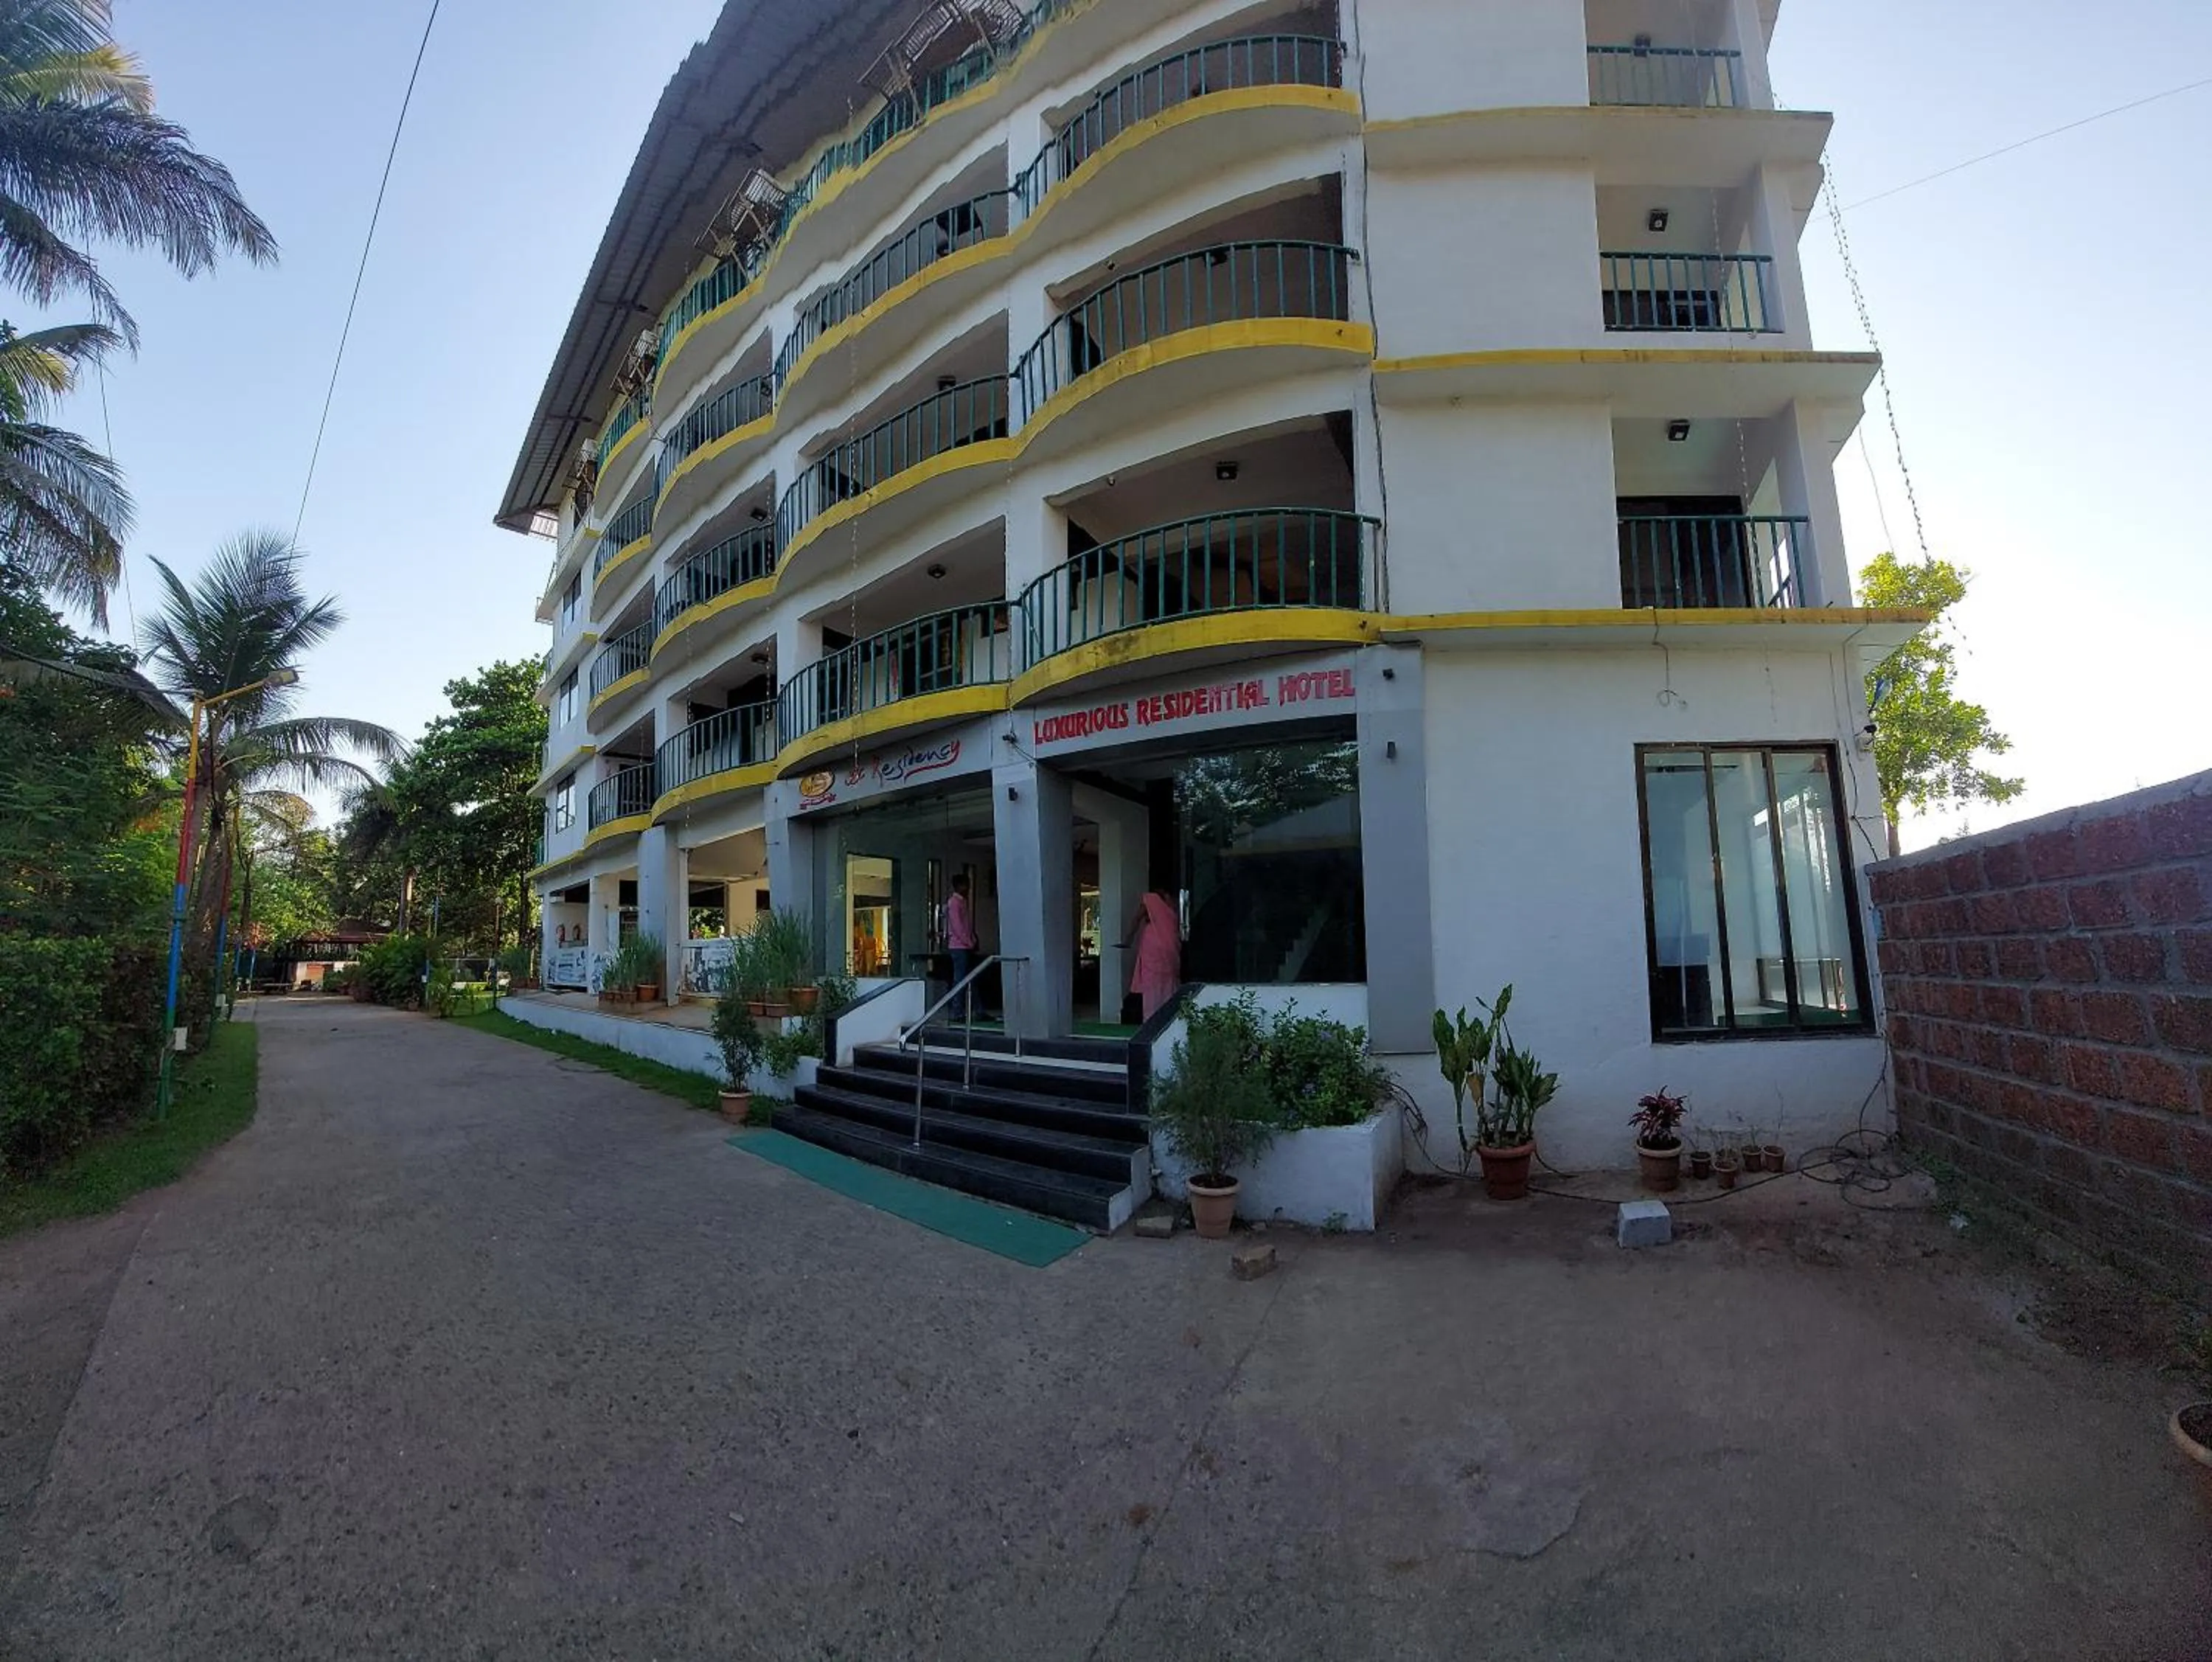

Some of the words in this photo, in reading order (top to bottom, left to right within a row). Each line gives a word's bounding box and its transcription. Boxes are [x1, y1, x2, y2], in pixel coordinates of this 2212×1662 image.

[1034, 703, 1129, 745] LUXURIOUS
[1136, 679, 1270, 726] RESIDENTIAL
[1278, 669, 1355, 706] HOTEL
[870, 738, 961, 788] Residency
